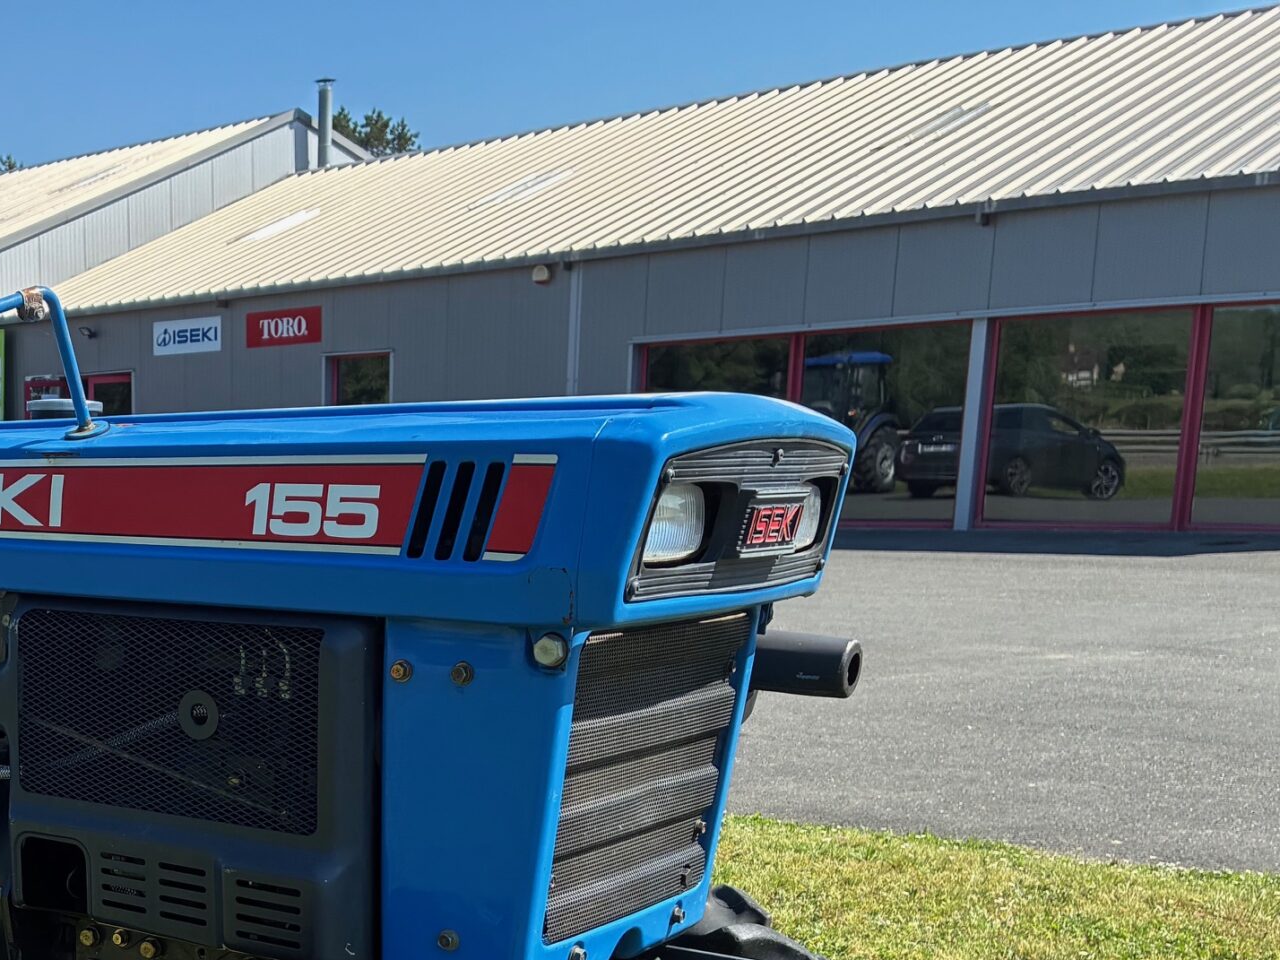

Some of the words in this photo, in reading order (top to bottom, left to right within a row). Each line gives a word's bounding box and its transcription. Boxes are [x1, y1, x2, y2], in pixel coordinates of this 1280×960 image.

[173, 326, 218, 345] ISEKI
[245, 483, 381, 538] 155
[746, 504, 804, 544] ISEKI
